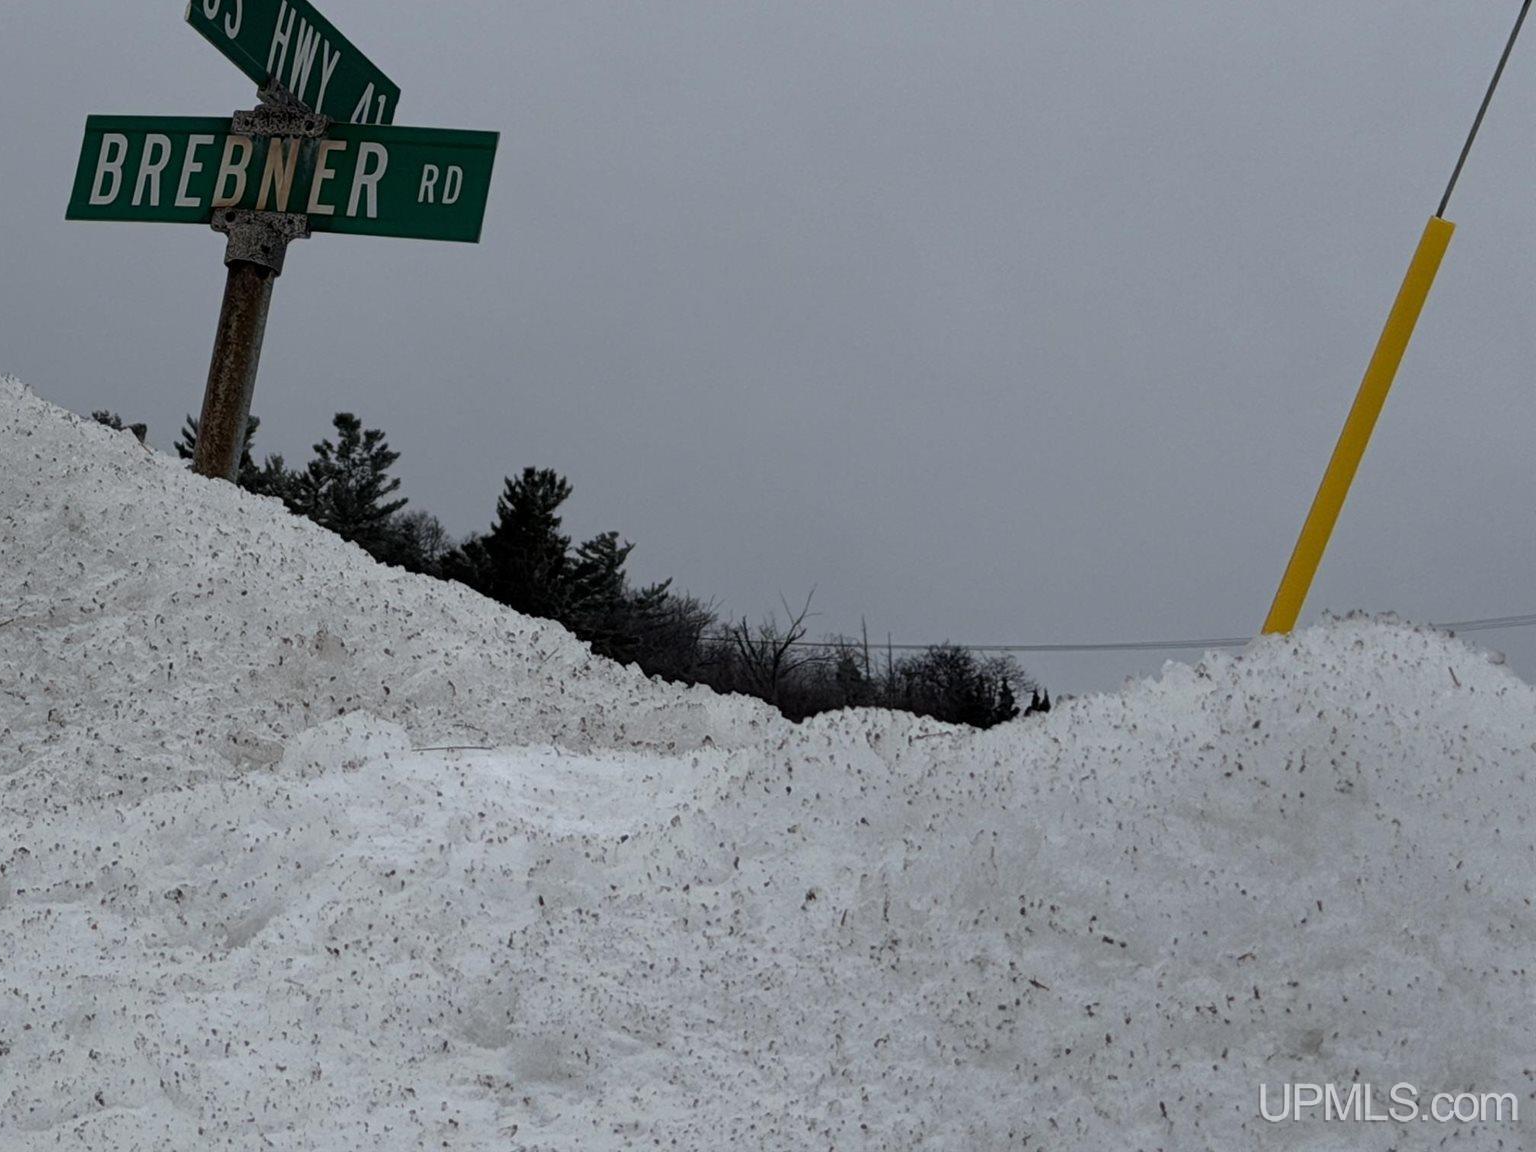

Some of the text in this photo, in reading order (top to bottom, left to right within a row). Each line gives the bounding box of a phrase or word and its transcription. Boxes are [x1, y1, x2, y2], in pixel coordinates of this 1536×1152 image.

[266, 0, 341, 114] HWY
[89, 133, 463, 218] BREBNER RD
